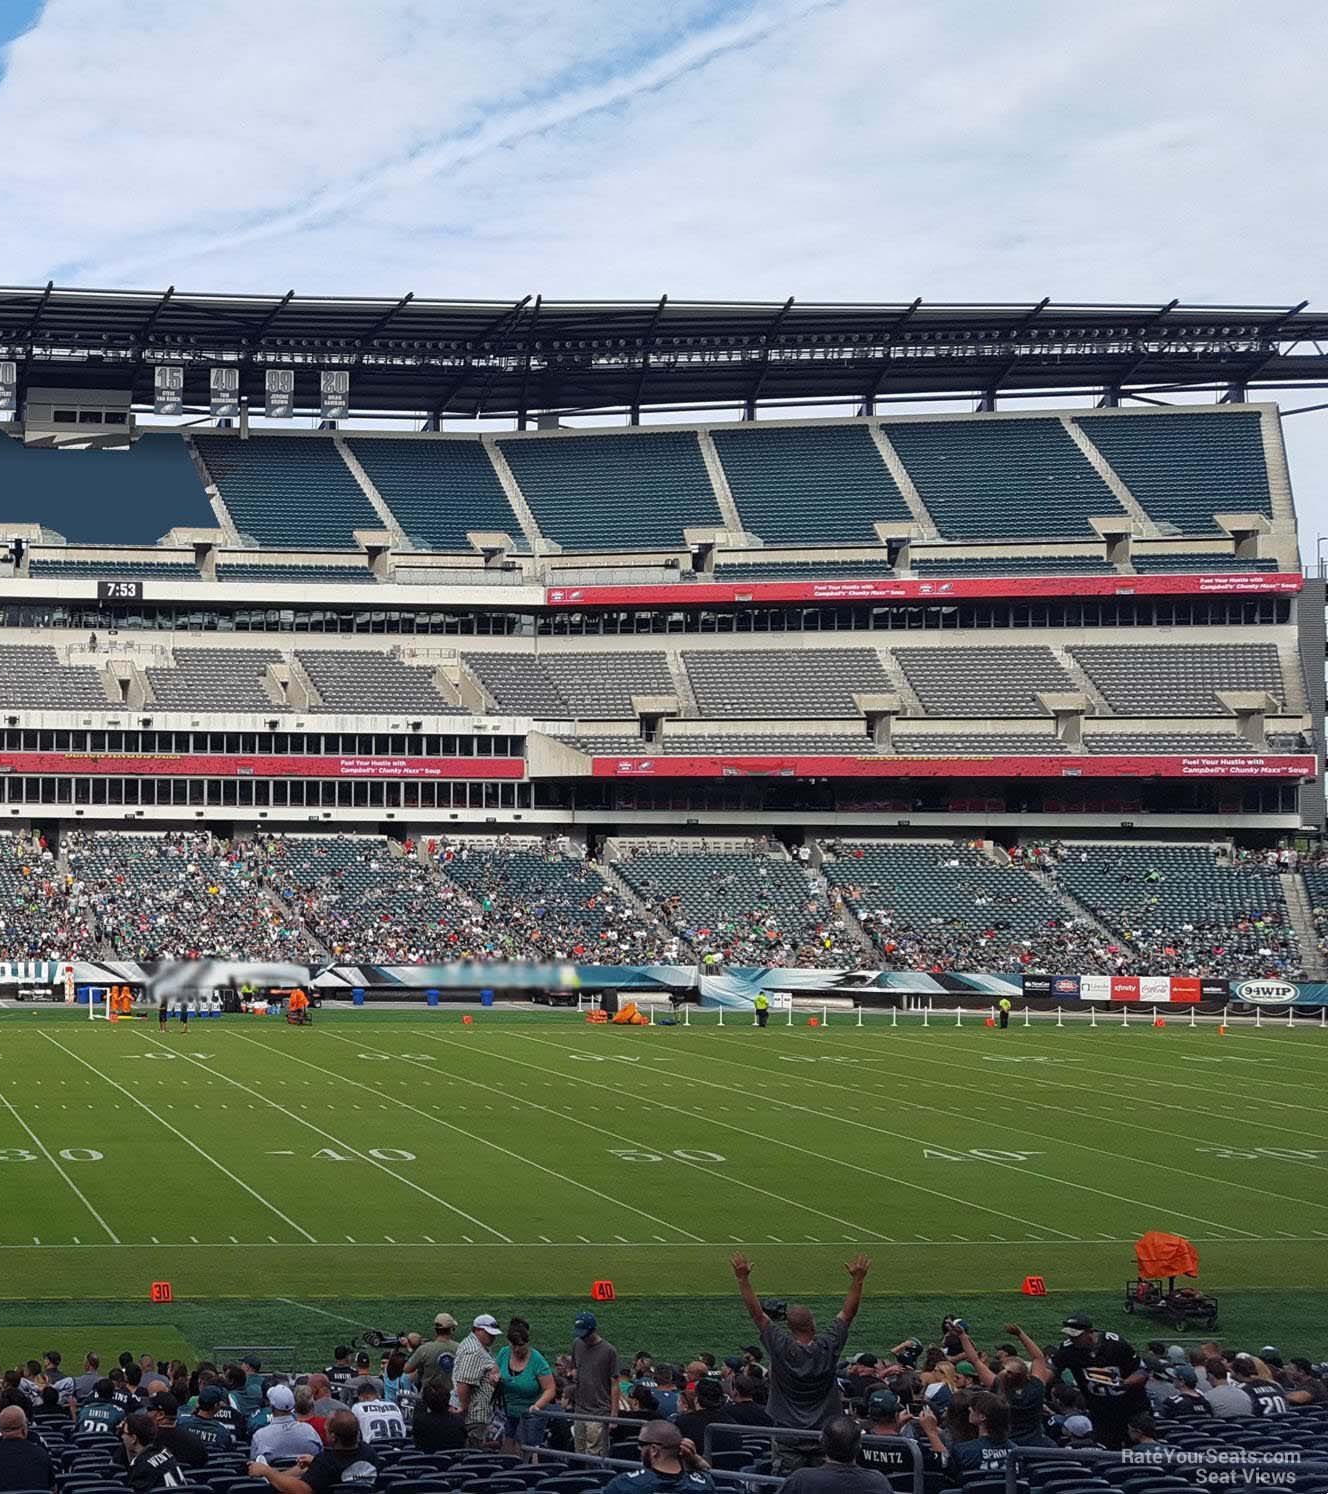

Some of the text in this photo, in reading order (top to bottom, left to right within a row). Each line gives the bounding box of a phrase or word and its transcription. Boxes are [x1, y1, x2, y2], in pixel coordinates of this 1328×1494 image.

[157, 367, 181, 390] 15
[212, 369, 237, 391] 40
[268, 370, 293, 393] 99
[323, 371, 348, 393] 20
[107, 583, 136, 597] 7:53
[1244, 986, 1292, 996] 94WIP
[311, 1148, 416, 1161] 40
[606, 1148, 727, 1161] 50
[923, 1149, 1028, 1161] 40
[152, 1284, 170, 1299] 30
[598, 1282, 614, 1299] 40
[1028, 1278, 1046, 1294] 50
[863, 1449, 903, 1464] WENTZ
